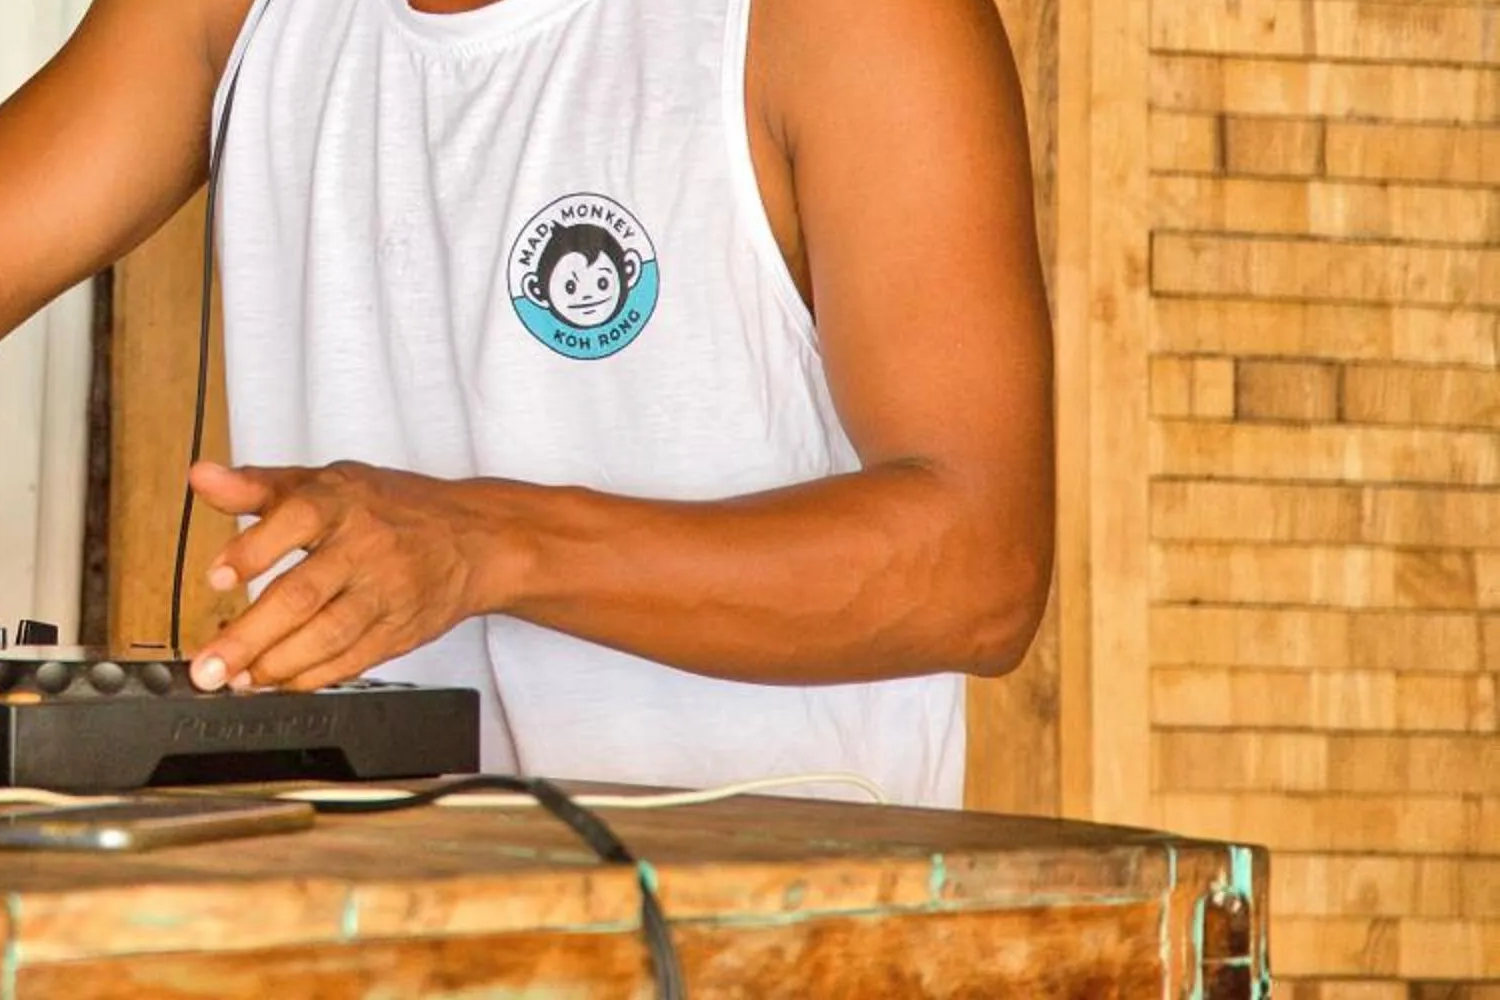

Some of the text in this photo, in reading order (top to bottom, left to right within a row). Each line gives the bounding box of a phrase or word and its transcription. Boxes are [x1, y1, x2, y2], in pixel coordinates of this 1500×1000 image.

[518, 204, 635, 266] MAD MONKEY
[553, 308, 641, 349] KOH RONG
